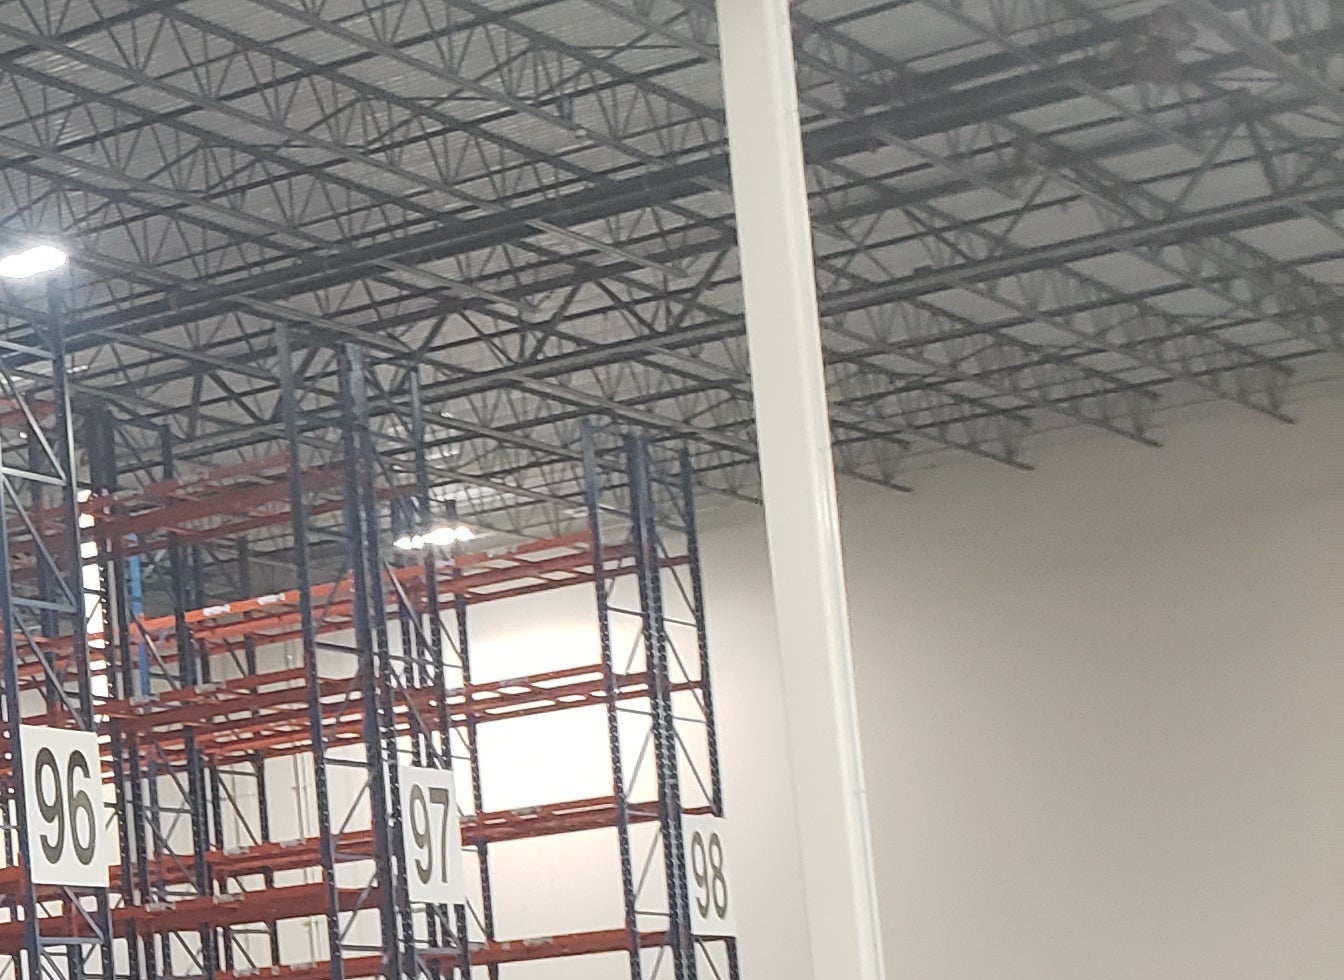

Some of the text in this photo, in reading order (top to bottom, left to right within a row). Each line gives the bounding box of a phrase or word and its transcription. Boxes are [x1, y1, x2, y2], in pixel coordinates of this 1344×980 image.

[33, 746, 96, 866] 96
[408, 783, 450, 886] 97
[690, 830, 729, 919] 98
